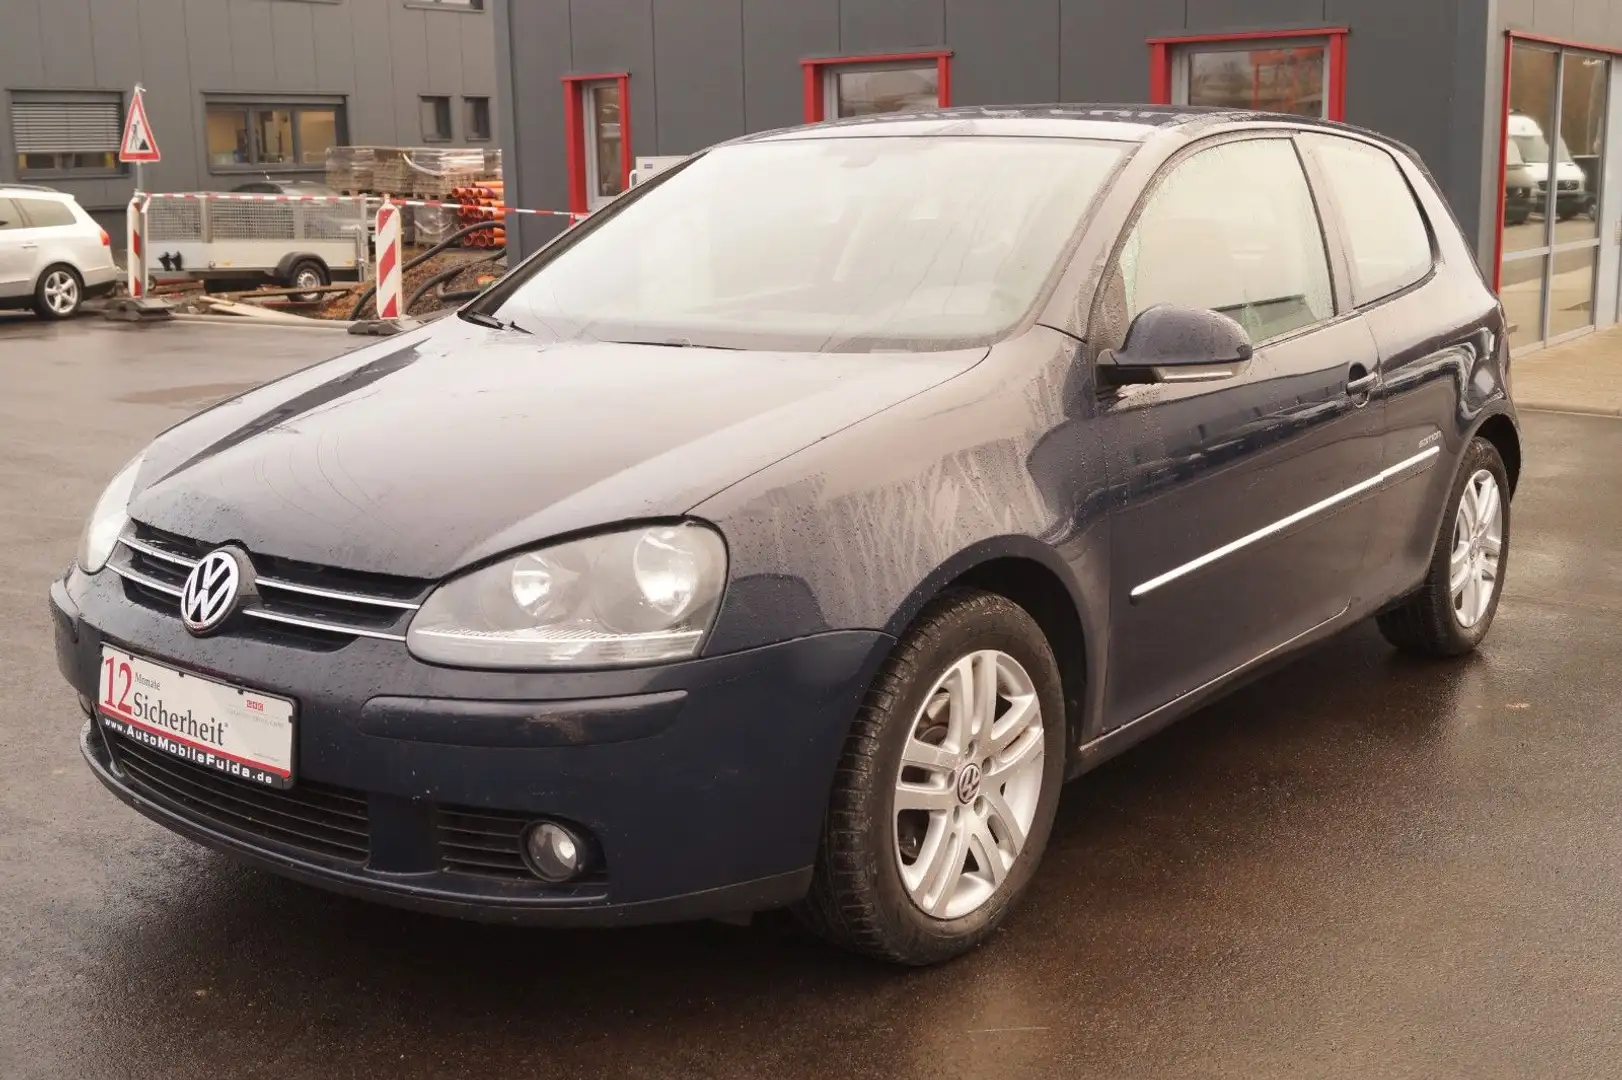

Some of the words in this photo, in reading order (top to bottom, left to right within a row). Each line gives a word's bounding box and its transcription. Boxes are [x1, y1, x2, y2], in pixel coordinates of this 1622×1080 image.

[181, 551, 239, 629] VW
[104, 656, 132, 715] 12
[104, 718, 273, 784] www.AutoMobileFulda.de
